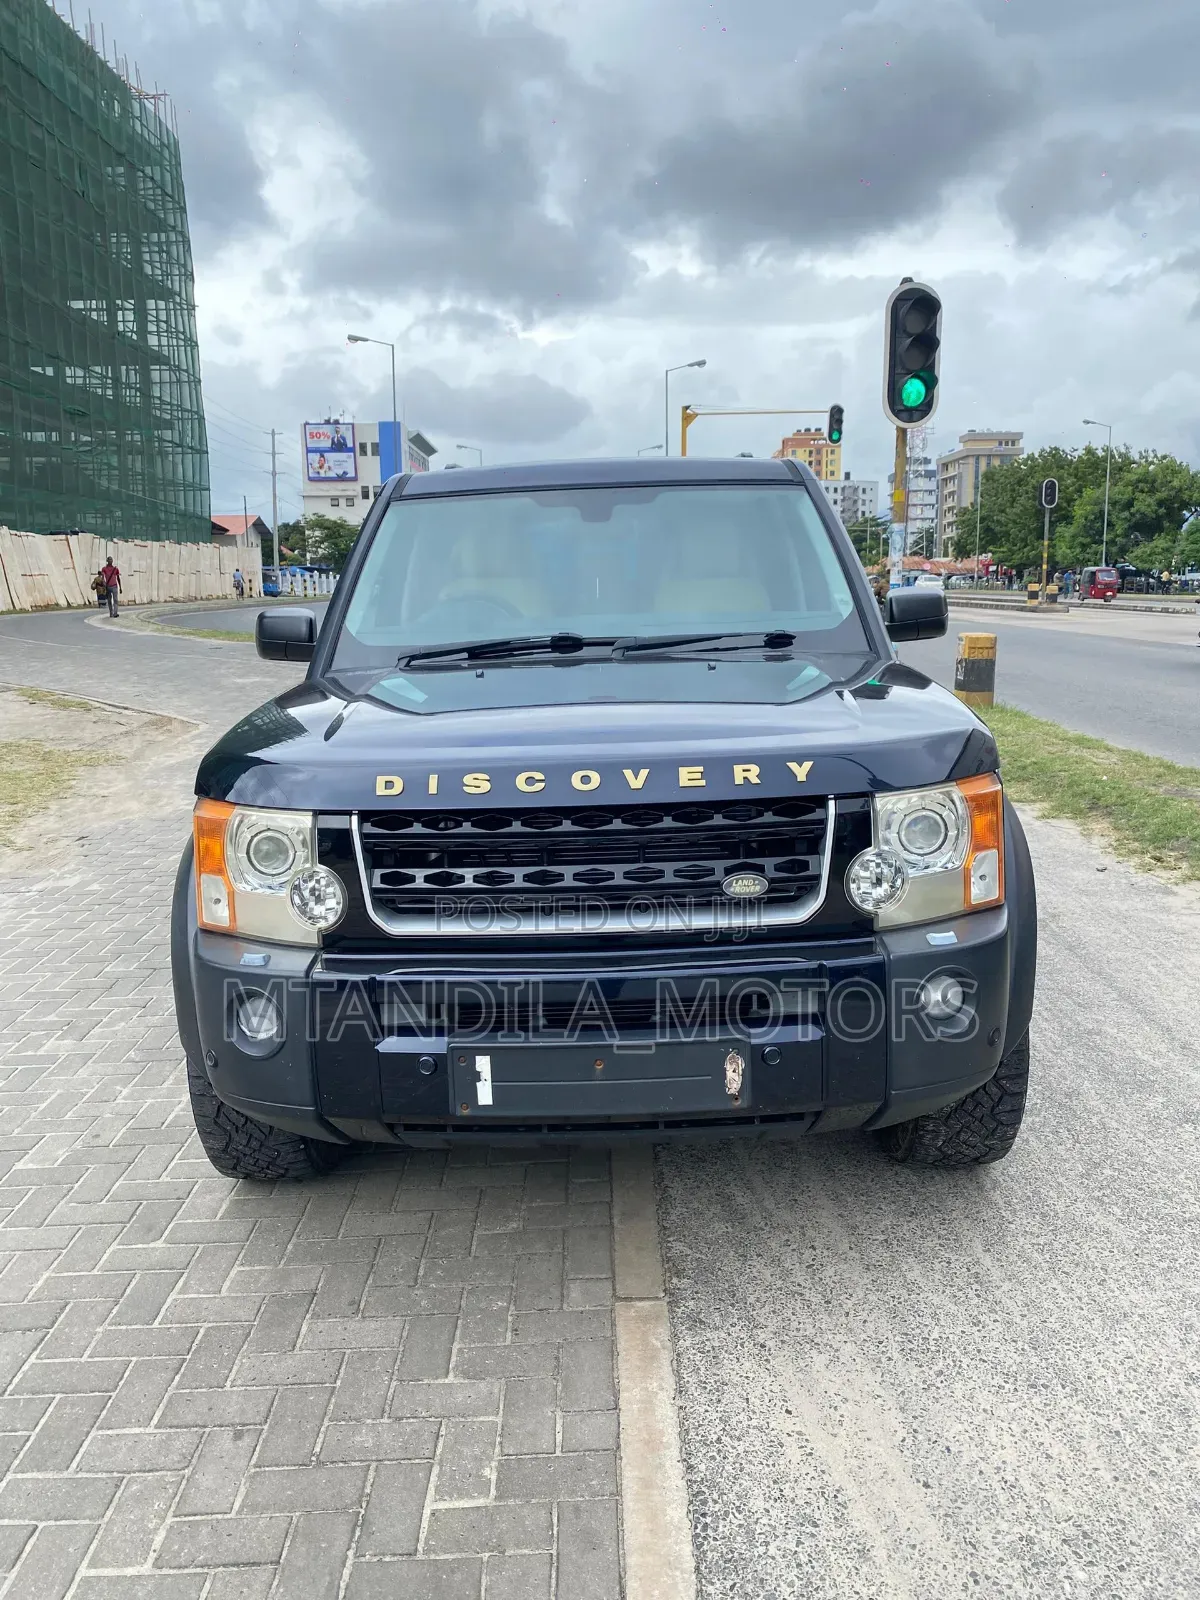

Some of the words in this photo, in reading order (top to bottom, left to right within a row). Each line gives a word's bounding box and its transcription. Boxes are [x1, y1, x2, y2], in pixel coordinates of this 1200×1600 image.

[308, 431, 331, 440] 50%
[375, 760, 815, 797] DISCOVERY
[732, 879, 754, 887] LAND
[734, 885, 761, 893] ROVER
